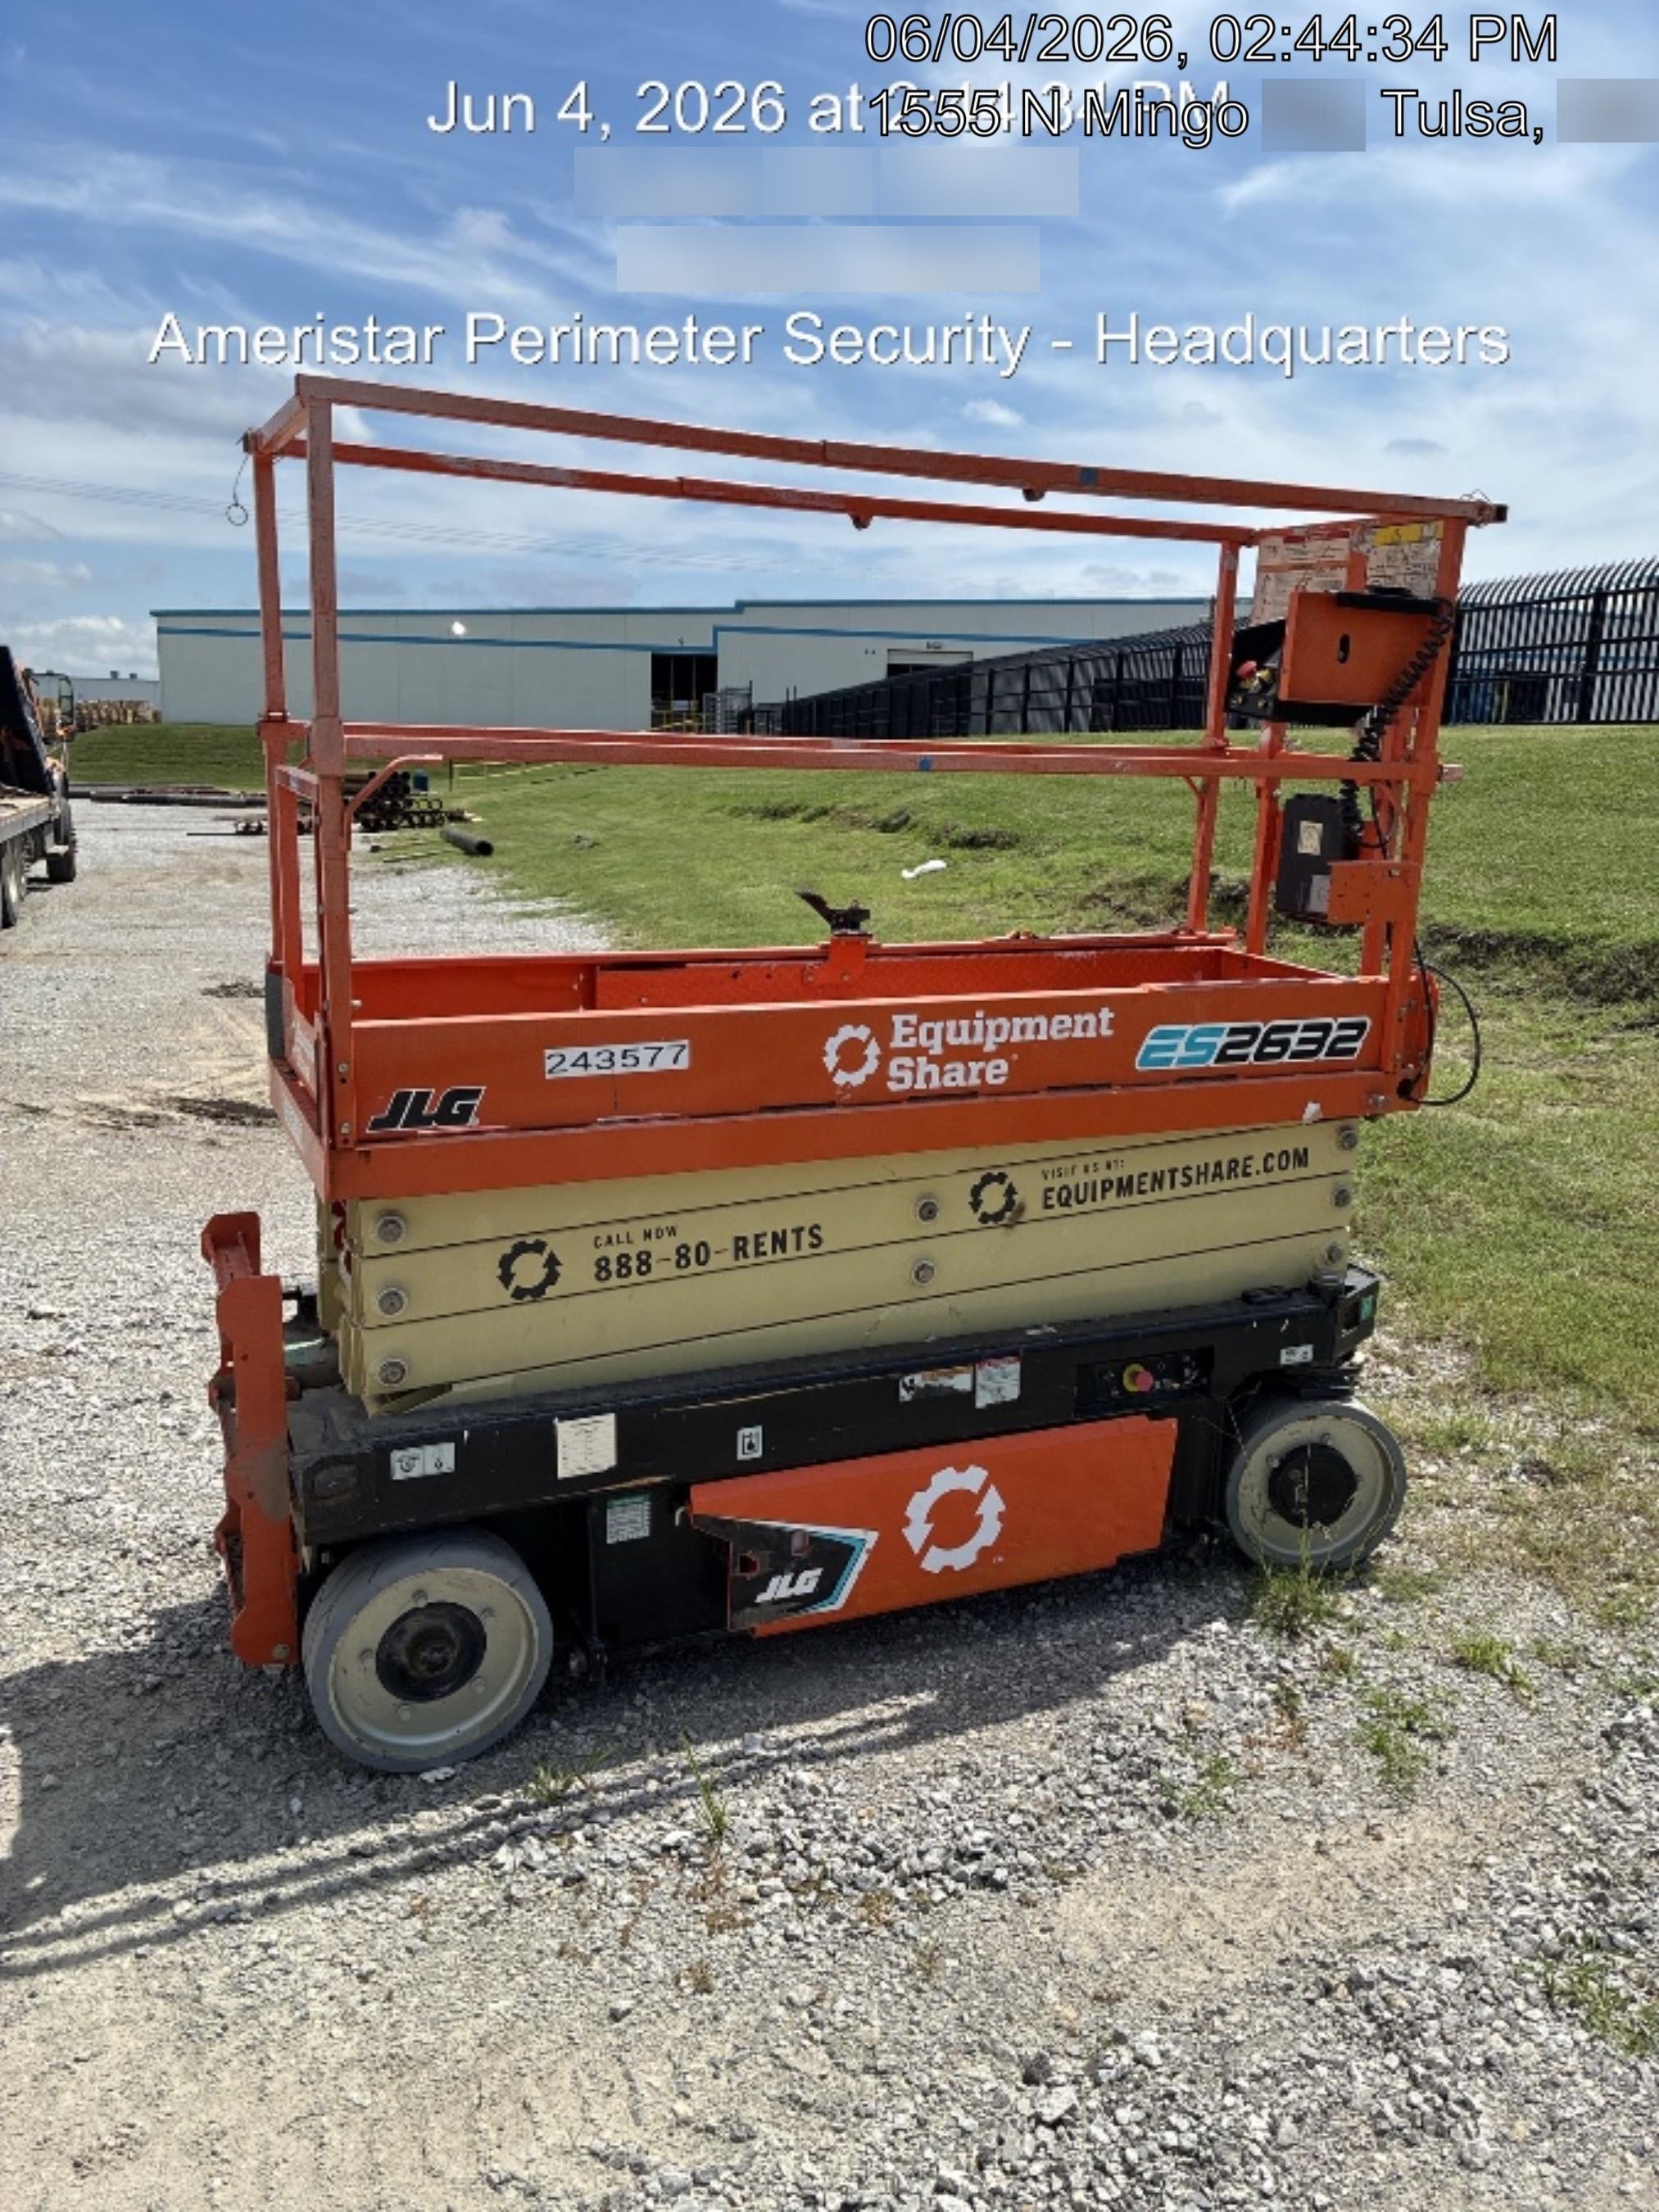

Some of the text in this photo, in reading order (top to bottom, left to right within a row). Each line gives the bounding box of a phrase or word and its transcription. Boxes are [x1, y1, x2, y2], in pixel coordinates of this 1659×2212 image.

[891, 1007, 1114, 1056] Equipment
[1135, 1017, 1371, 1070] ES2632
[546, 1043, 688, 1076] 243577
[887, 1055, 1009, 1092] Share
[367, 1086, 487, 1134] JLG
[1042, 1147, 1309, 1210] EQUIPMENTSHARE.COM
[593, 1226, 678, 1249] CALL NOW
[593, 1224, 824, 1282] 888-80-RENTS
[754, 1567, 824, 1604] JLG
